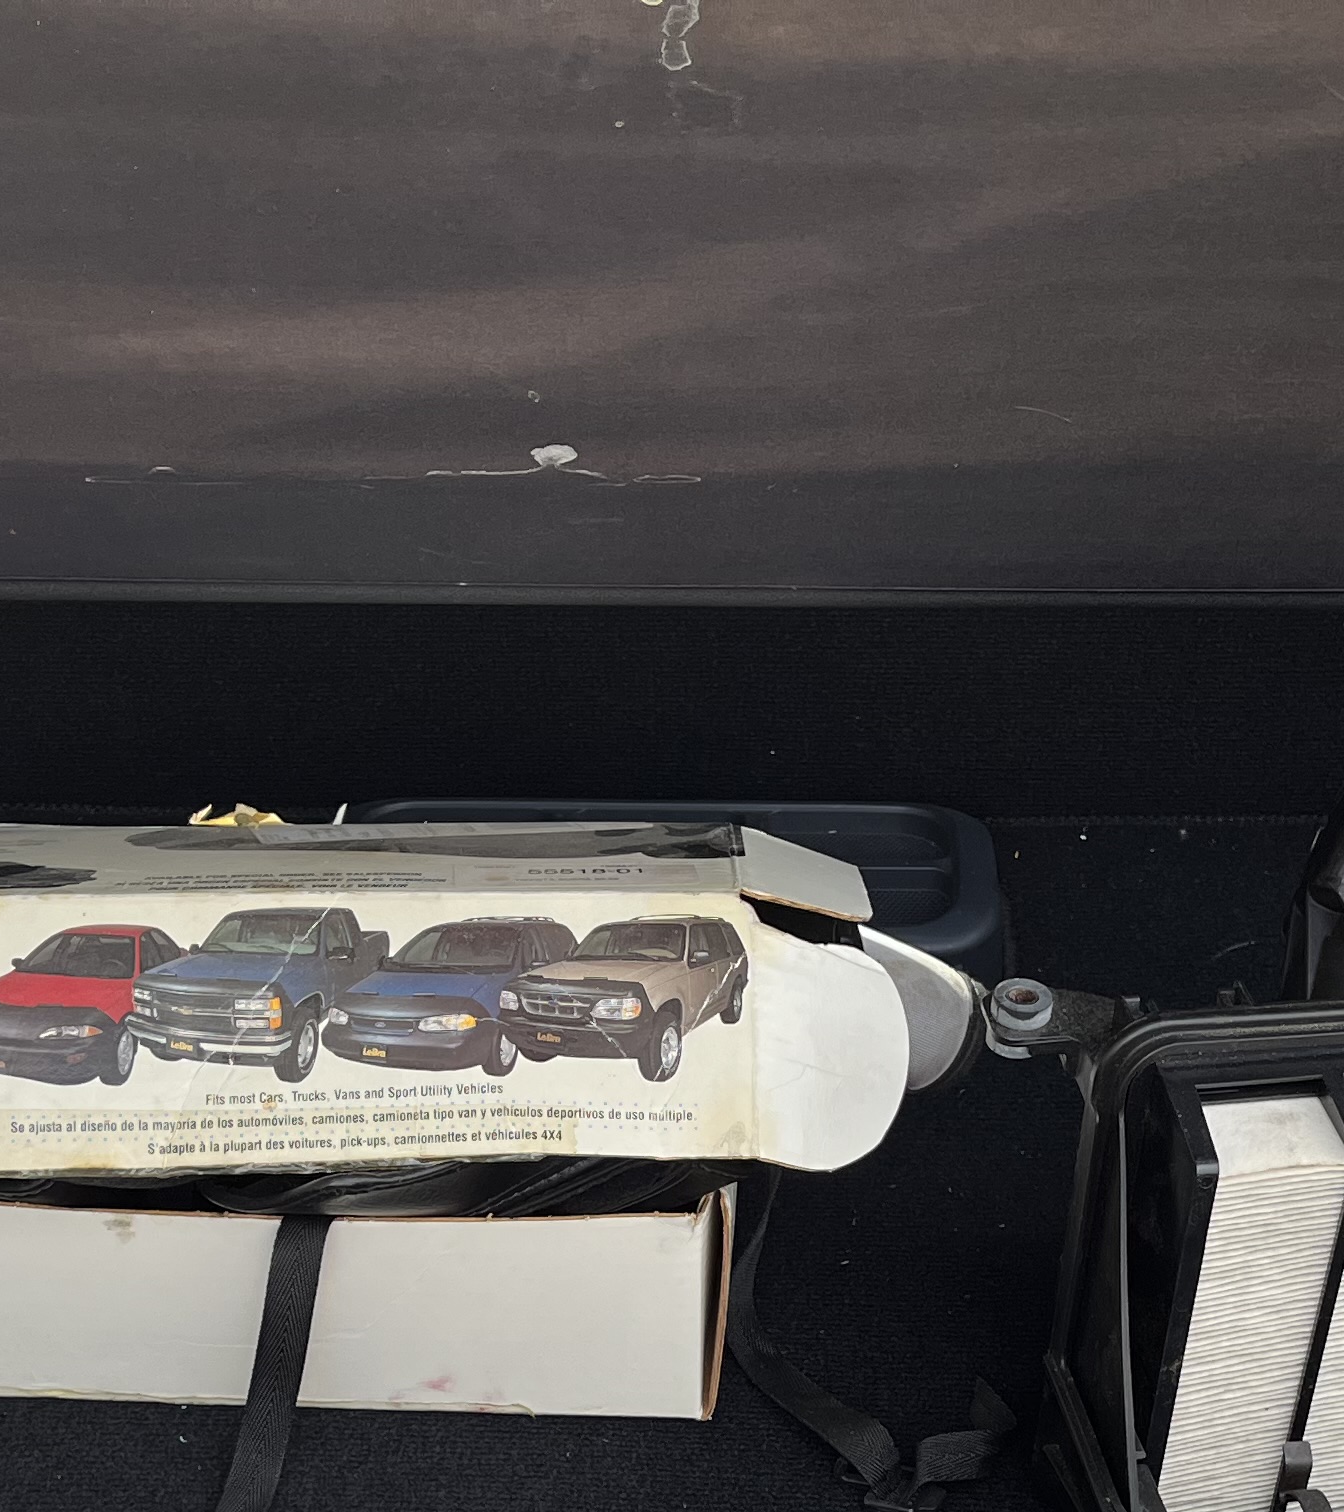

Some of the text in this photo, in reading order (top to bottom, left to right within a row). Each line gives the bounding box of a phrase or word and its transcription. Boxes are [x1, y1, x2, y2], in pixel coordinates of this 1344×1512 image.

[205, 1083, 504, 1106] Fits most Cars, Trucks, Vans and Sport Utility Vehicles
[10, 1105, 698, 1136] Se ajusta al diseño de la mayoría de los automóviles, camiones, camioneta tipo van y vehículos deportivos de uso múltiple.
[147, 1128, 563, 1157] S'adapte à la plupart des voitures, pick-ups, camionnettes et véhicules 4X4
